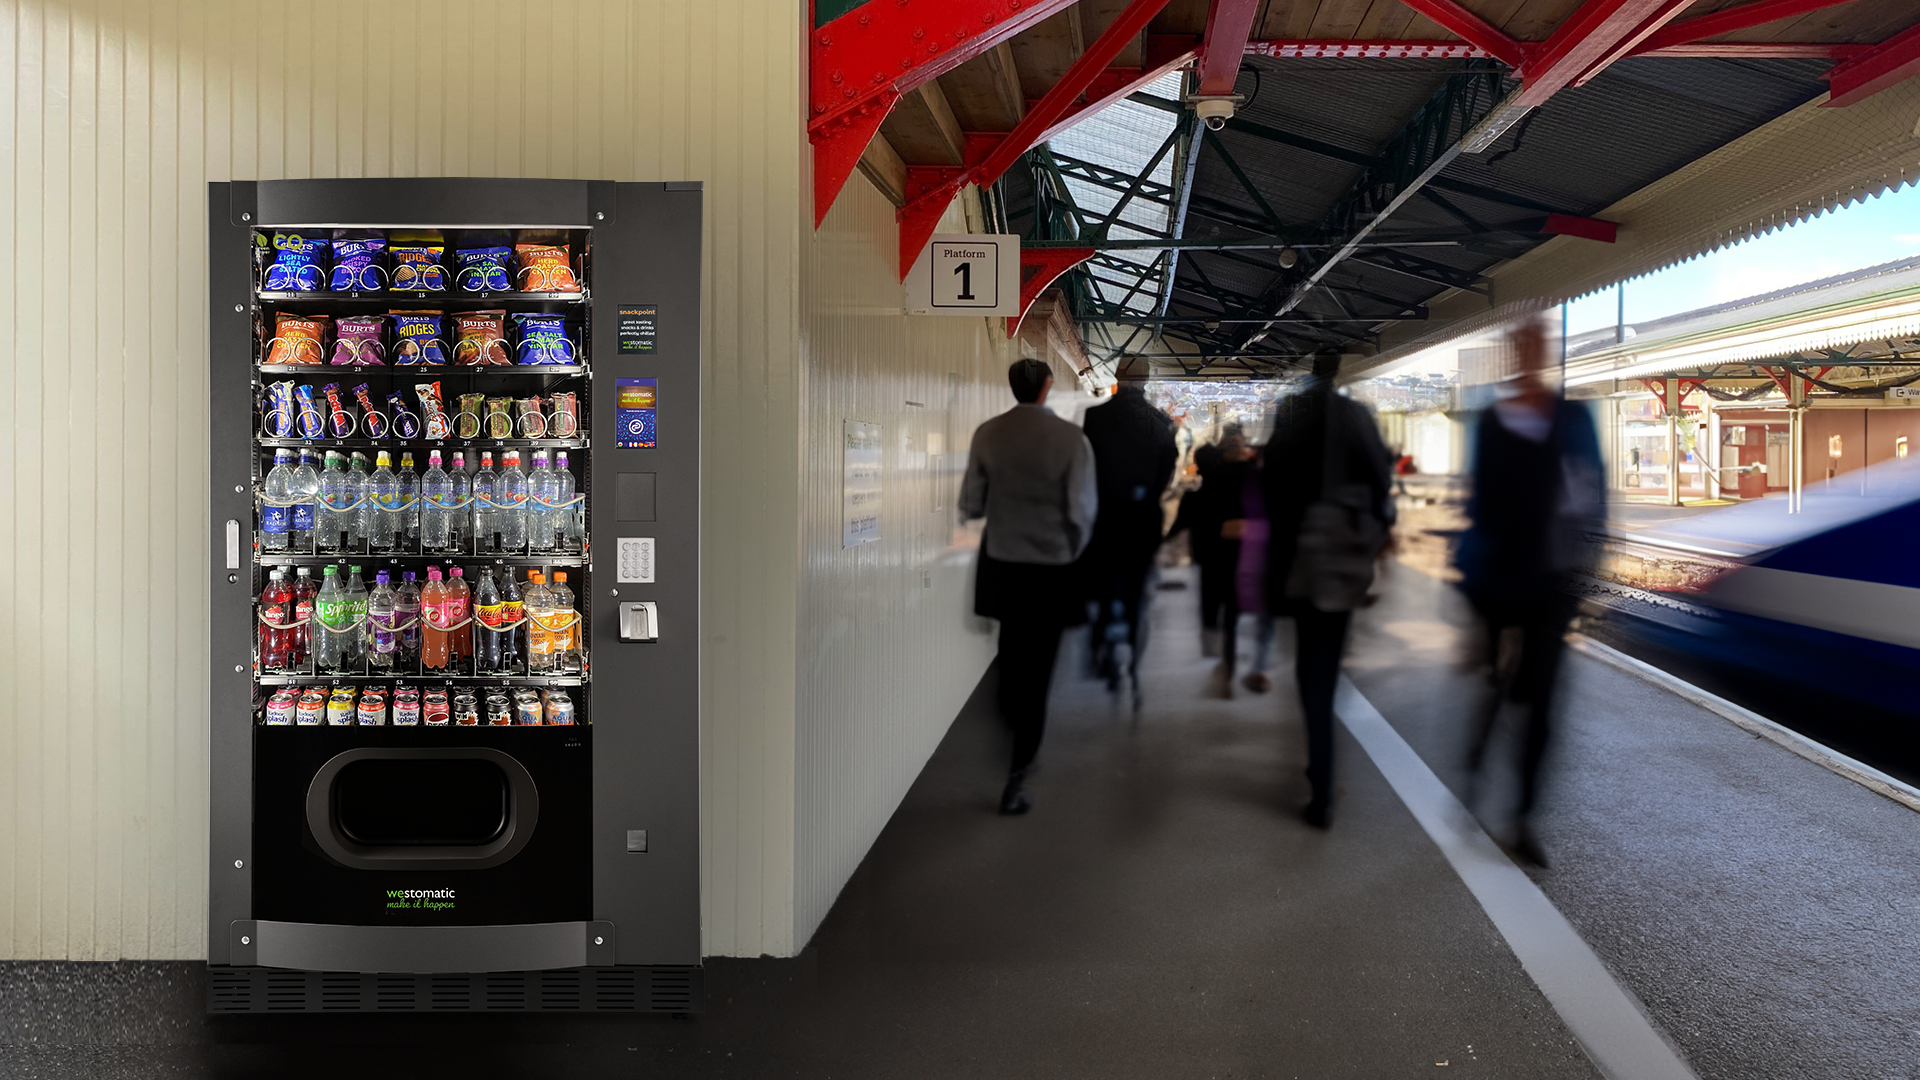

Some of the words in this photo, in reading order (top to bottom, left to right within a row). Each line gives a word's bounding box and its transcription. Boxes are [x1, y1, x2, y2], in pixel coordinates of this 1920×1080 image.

[279, 254, 310, 262] LIGHTLY
[944, 249, 985, 258] Platform
[954, 262, 975, 300] 1
[462, 319, 497, 328] BURTS
[341, 324, 376, 333] BURTS
[400, 324, 435, 337] RIDGES
[296, 605, 313, 614] Tango
[265, 611, 285, 619] Tango
[396, 716, 418, 724] splash
[386, 887, 456, 899] westomatic
[386, 898, 412, 909] make
[412, 898, 421, 909] it
[423, 897, 456, 911] happen
